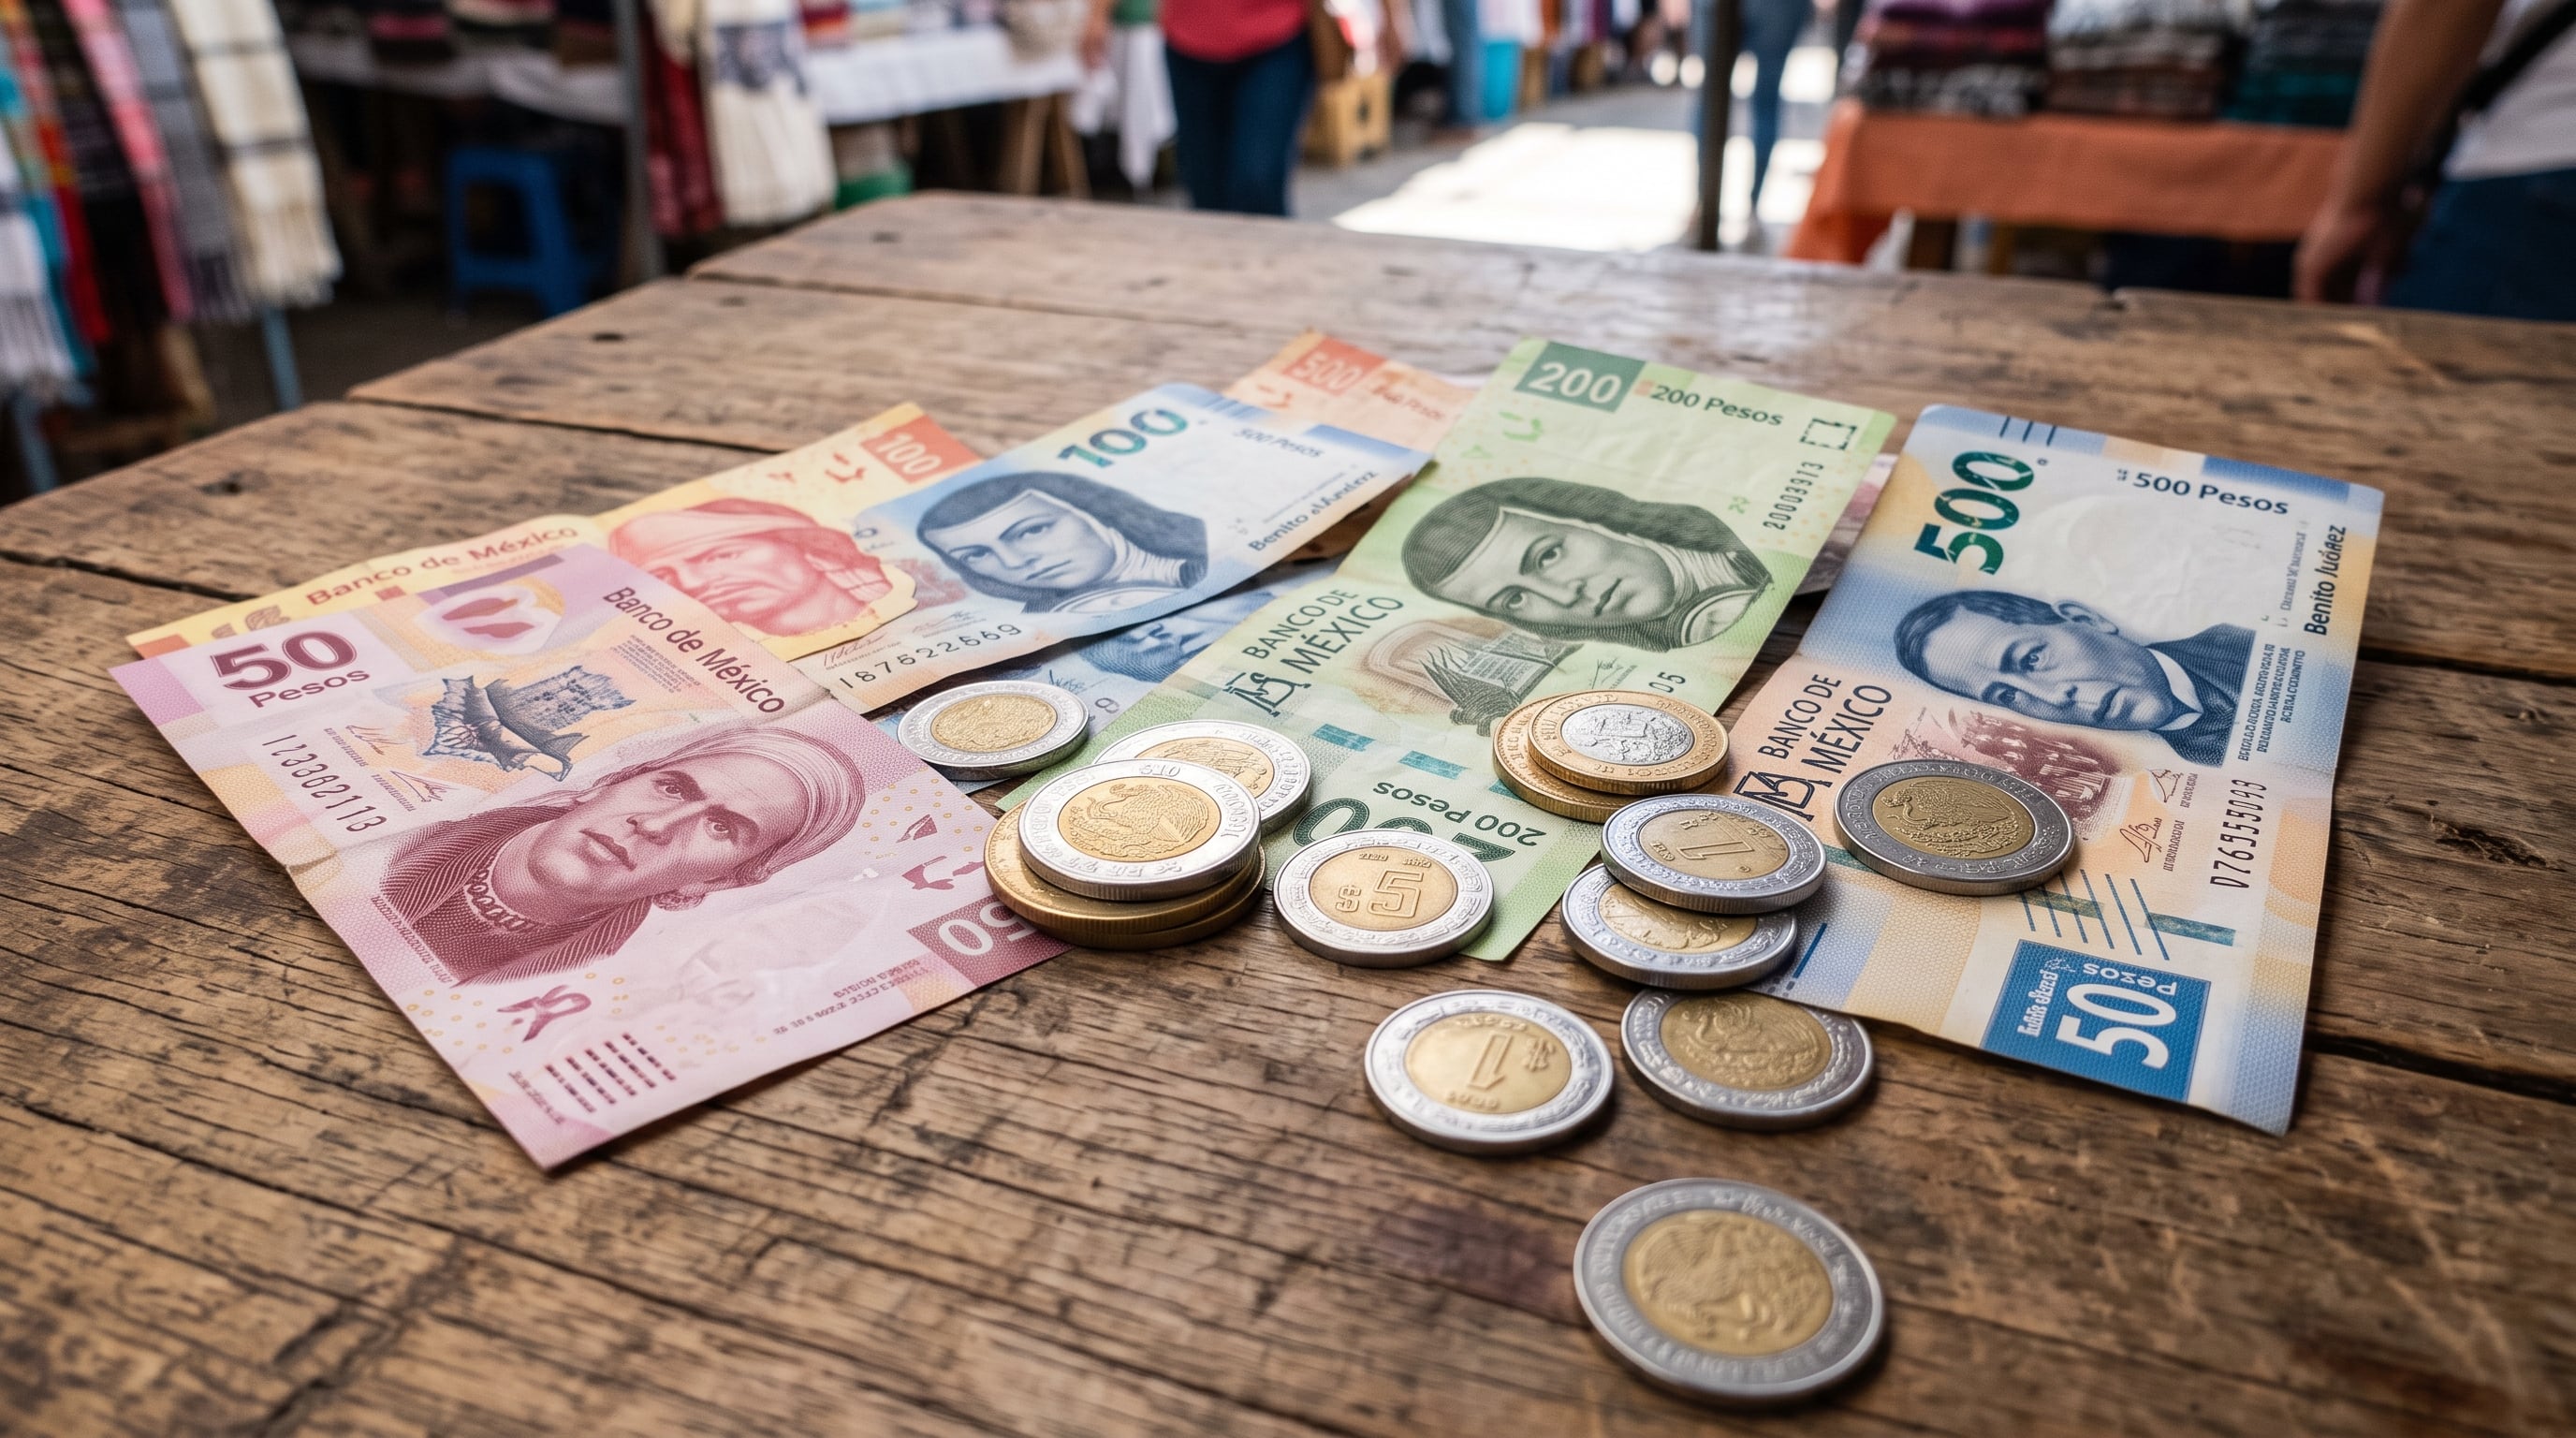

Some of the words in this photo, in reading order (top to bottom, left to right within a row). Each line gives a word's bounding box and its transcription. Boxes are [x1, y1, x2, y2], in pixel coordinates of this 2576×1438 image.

[1528, 360, 1623, 404] 200
[1650, 384, 1700, 409] 200
[1704, 396, 1784, 428] Pesos
[874, 433, 943, 477] 100
[1056, 407, 1189, 469] 100
[1914, 450, 2035, 576] 500
[2132, 471, 2191, 497] 500
[2198, 481, 2290, 516] Pesos
[306, 564, 413, 607] Banco
[421, 553, 462, 572] de
[467, 526, 579, 563] México
[1242, 603, 1327, 661] BANCO
[1328, 588, 1360, 612] DE
[1280, 594, 1405, 676] MÉXICO
[2305, 575, 2339, 637] Benito
[210, 630, 359, 692] 50
[602, 586, 674, 633] Banco
[666, 629, 704, 653] de
[695, 647, 786, 713] México
[248, 668, 372, 710] Pesos
[1759, 697, 1823, 760] BANCO
[1816, 674, 1842, 699] DE
[1800, 683, 1893, 787] MÉXICO
[1372, 781, 1473, 825] Pesos
[1476, 813, 1548, 848] 200
[1368, 868, 1424, 918] 5
[938, 899, 1041, 957] 50
[2055, 983, 2178, 1070] 50
